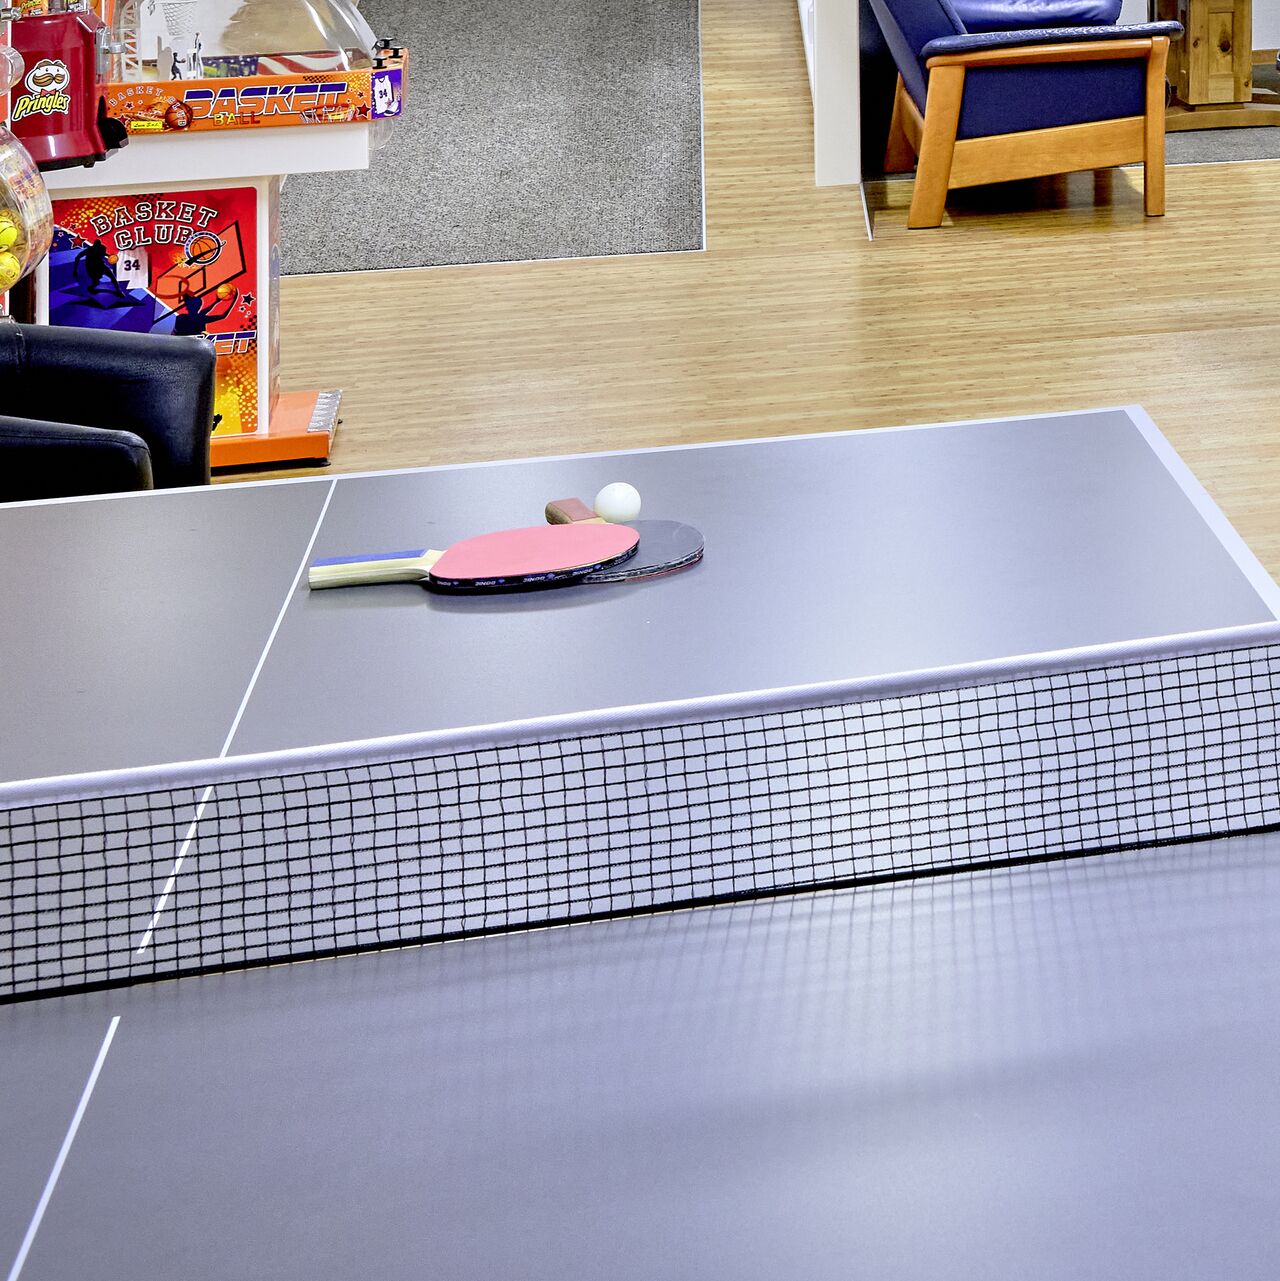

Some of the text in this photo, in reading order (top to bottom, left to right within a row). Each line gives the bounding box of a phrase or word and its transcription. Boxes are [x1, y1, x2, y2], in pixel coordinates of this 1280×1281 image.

[13, 92, 70, 121] Pringles
[109, 85, 164, 107] BASKET
[183, 81, 348, 120] BASKET
[378, 88, 388, 99] 34
[167, 96, 187, 127] CLUB
[213, 111, 261, 127] BALL
[89, 200, 218, 237] BASKET
[113, 224, 194, 251] CLUB
[123, 258, 141, 272] 34
